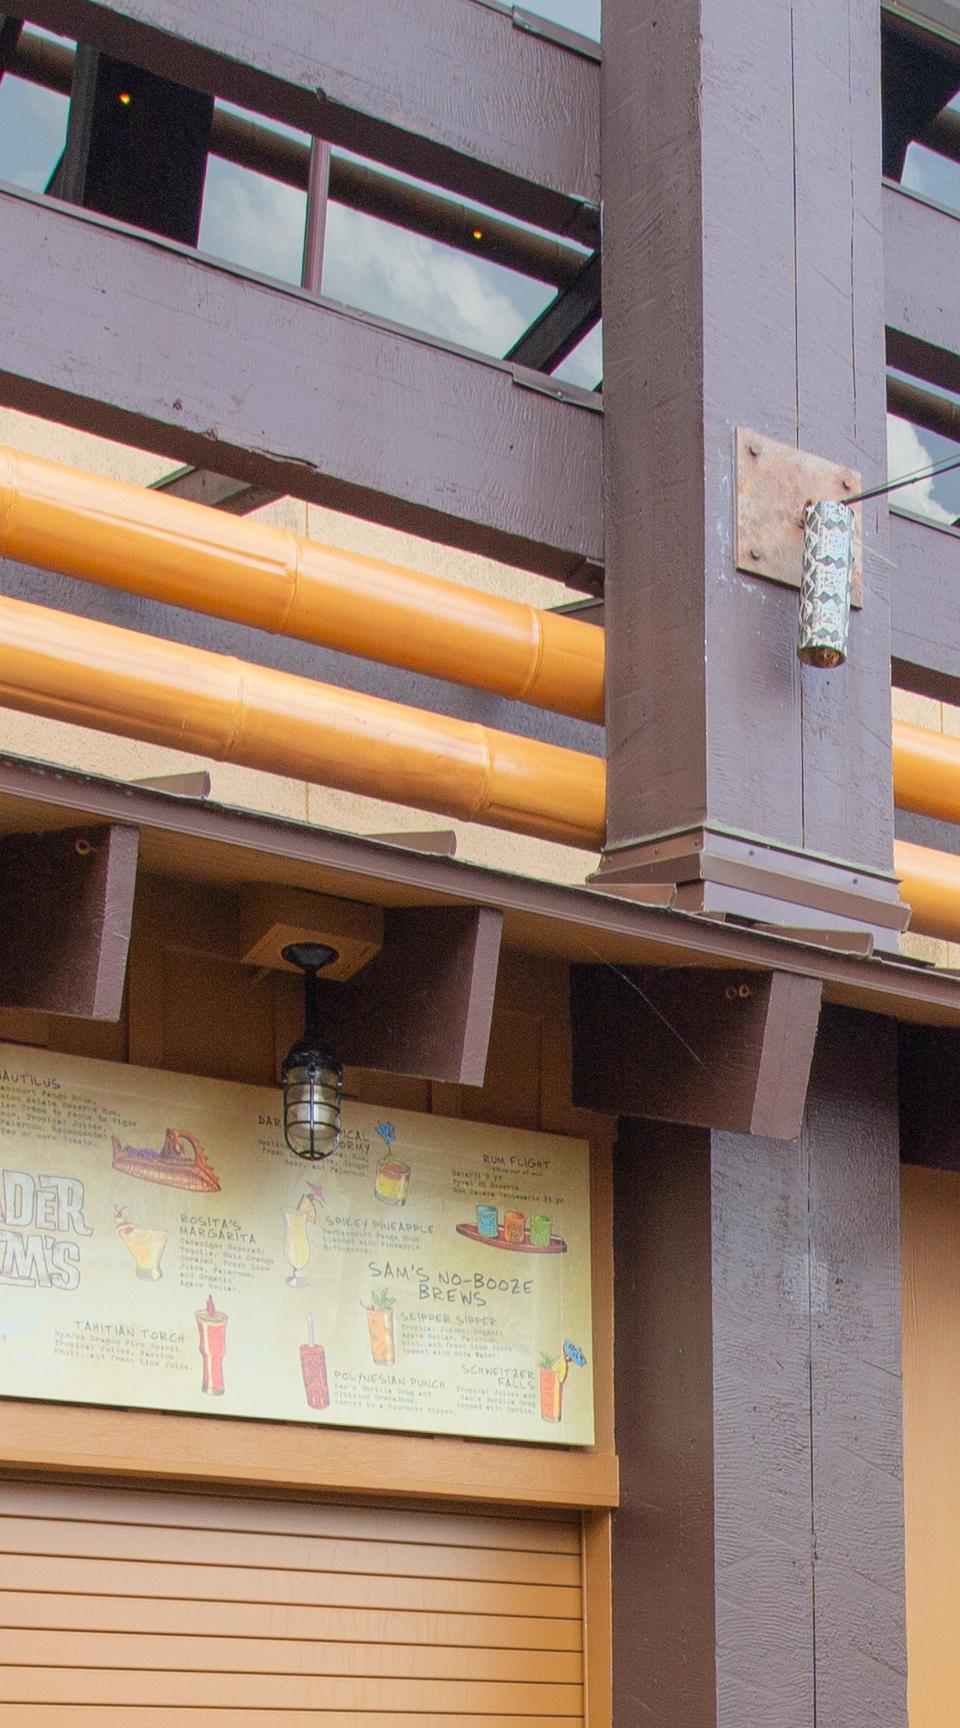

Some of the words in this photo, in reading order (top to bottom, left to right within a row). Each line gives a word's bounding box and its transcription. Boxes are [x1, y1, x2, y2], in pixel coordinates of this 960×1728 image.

[0, 1069, 61, 1089] AUTILUS
[258, 1115, 283, 1128] DAR
[482, 1153, 506, 1166] RUM
[510, 1156, 551, 1170] FLIGHT
[0, 1169, 94, 1236] DER
[181, 1214, 242, 1232] ROSITA'S
[373, 1219, 435, 1234] PINEAPPLE
[180, 1226, 256, 1244] MARGARITA
[368, 1261, 430, 1283] SAM'S
[438, 1271, 534, 1295] NO-BOOZE
[418, 1284, 487, 1307] BREWS
[456, 1314, 497, 1327] SIPPER
[74, 1320, 135, 1337] TAHITIAN
[141, 1328, 185, 1343] TORCH
[335, 1371, 405, 1386] POLYNESIAN
[410, 1377, 446, 1390] PUNCH
[462, 1364, 535, 1379] SCHWEITZER
[497, 1377, 536, 1391] FALLS
